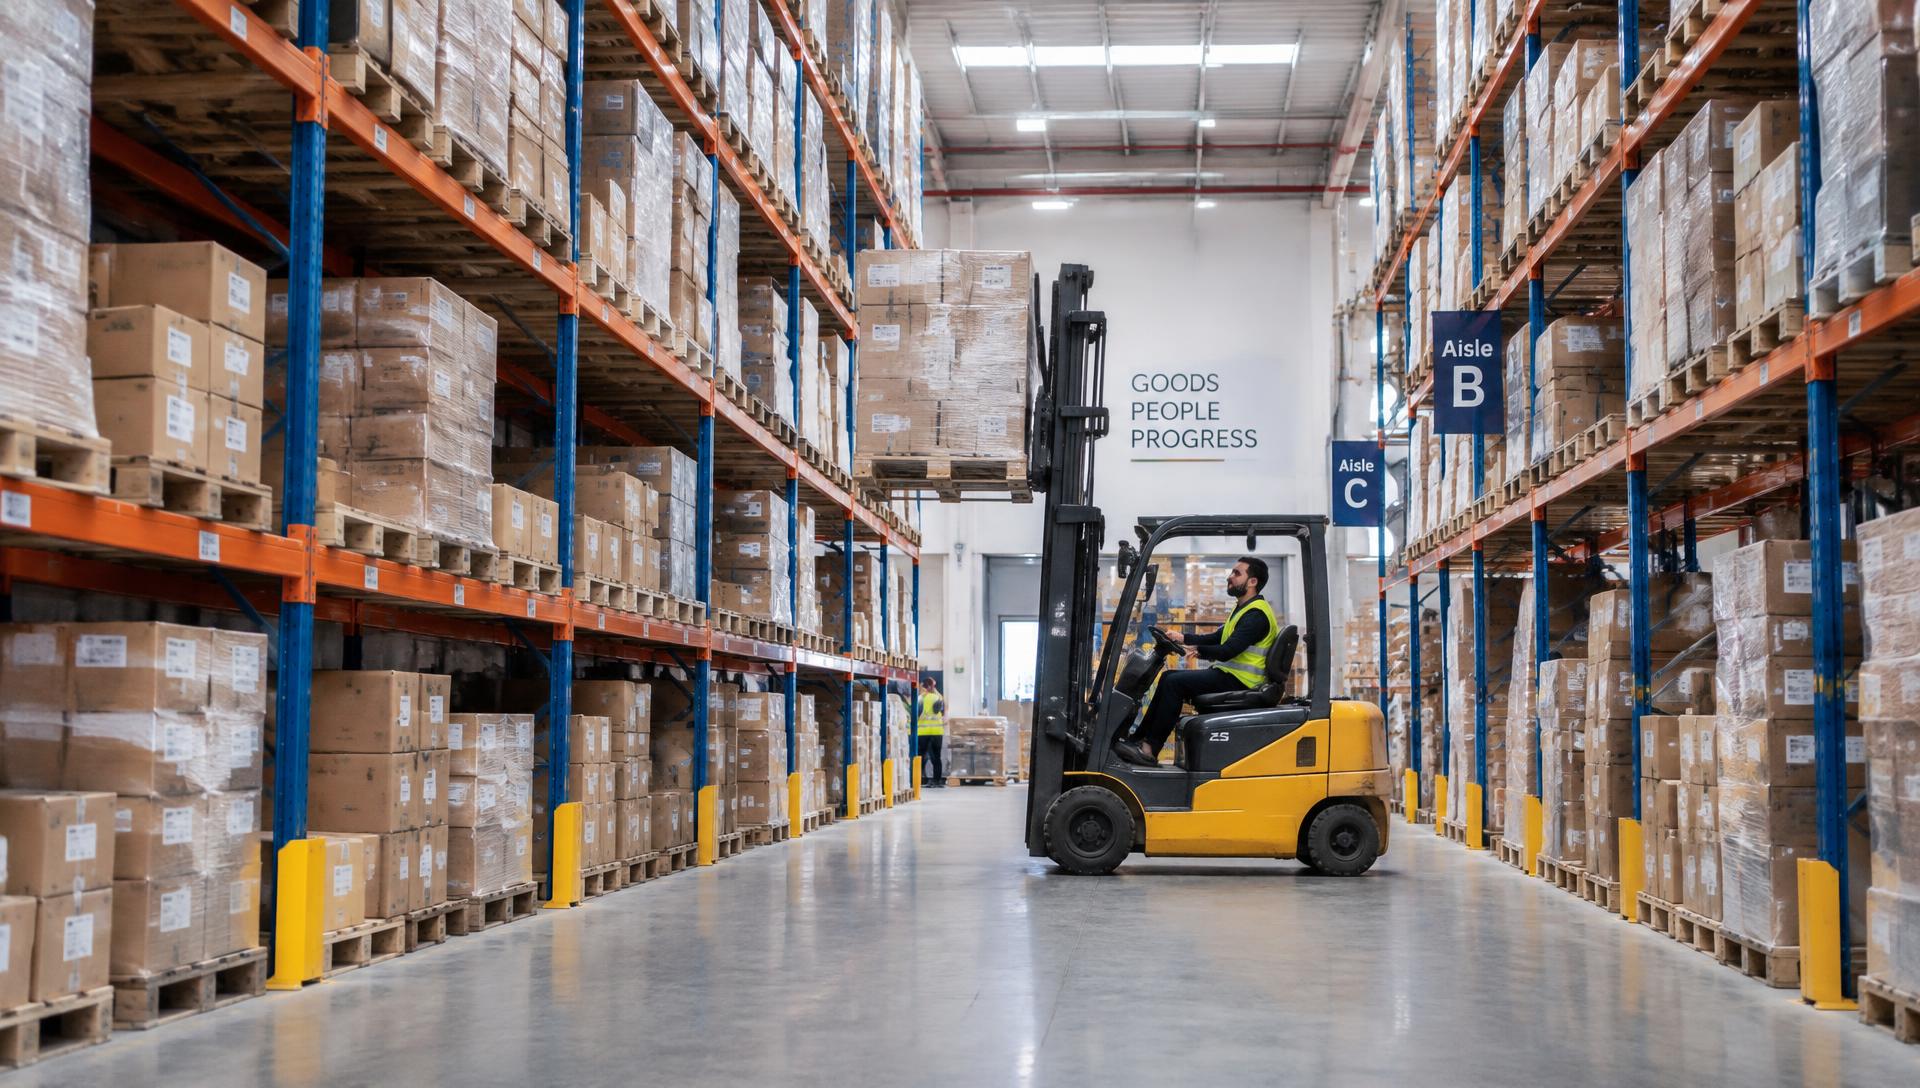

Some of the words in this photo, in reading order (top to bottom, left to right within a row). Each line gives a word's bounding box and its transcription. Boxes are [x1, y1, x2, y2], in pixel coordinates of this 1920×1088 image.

[1441, 338, 1494, 358] Aisle
[1131, 373, 1219, 393] GOODS
[1453, 365, 1485, 408] B
[1131, 401, 1220, 421] PEOPLE
[1131, 429, 1258, 449] PROGRESS
[1338, 458, 1375, 473] Aisle
[1344, 477, 1368, 509] C
